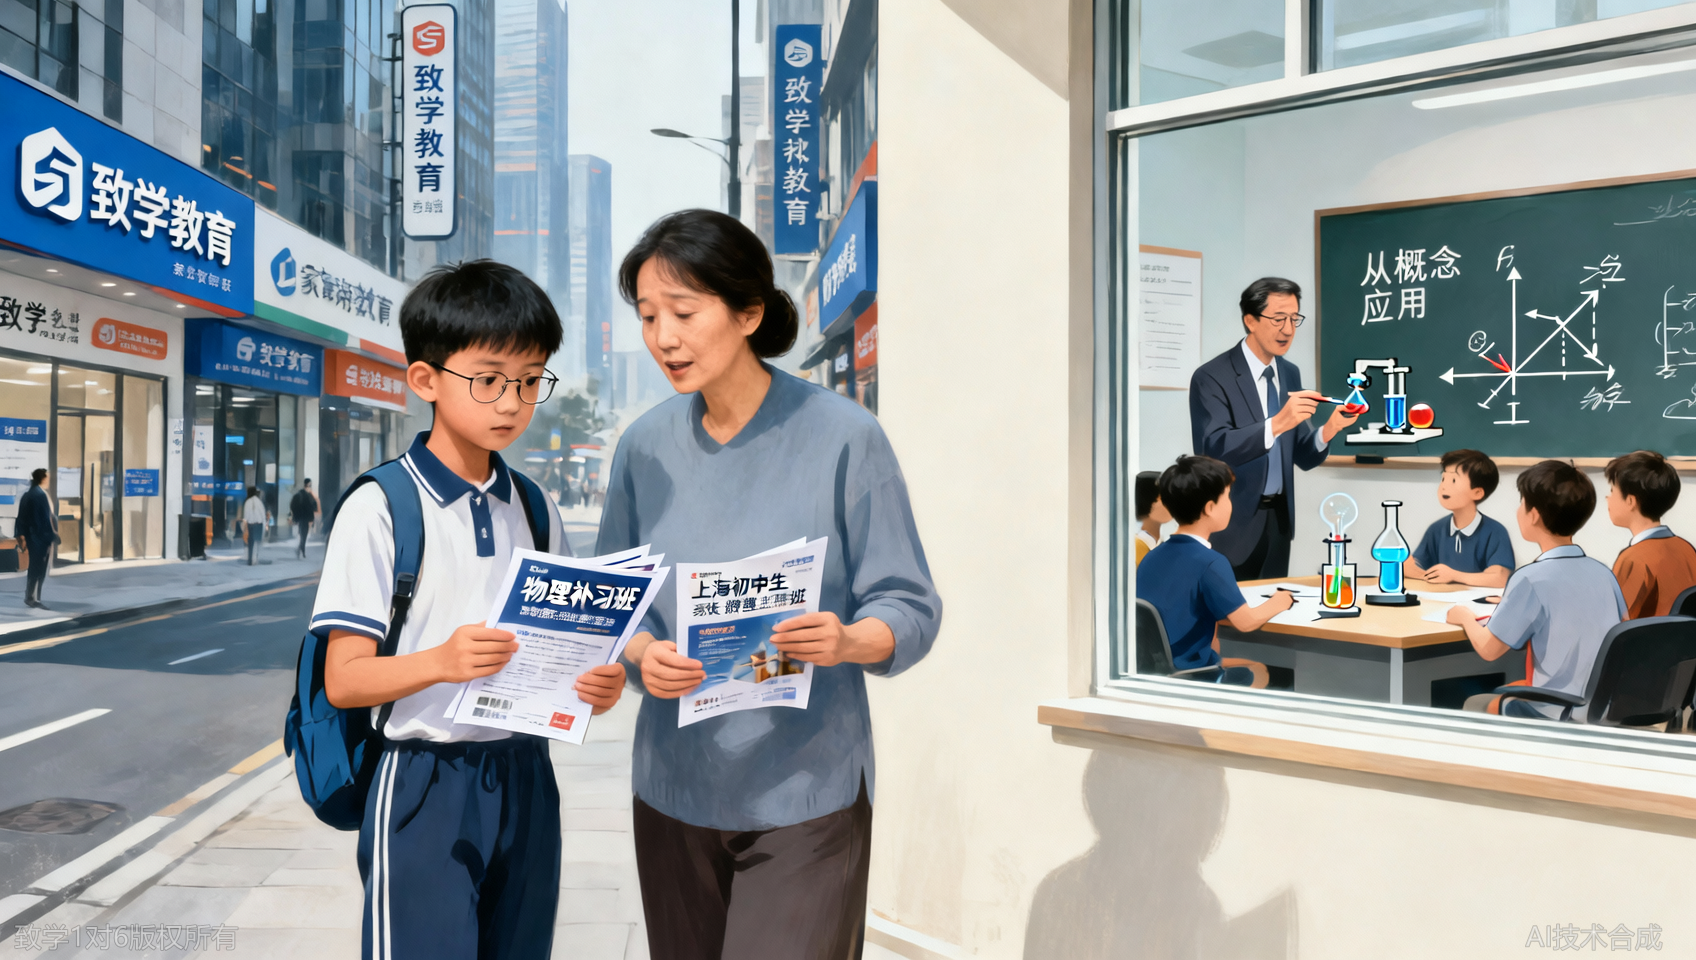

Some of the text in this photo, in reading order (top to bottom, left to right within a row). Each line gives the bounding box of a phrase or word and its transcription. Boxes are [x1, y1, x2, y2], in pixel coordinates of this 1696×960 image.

[413, 64, 445, 193] 致学教育
[90, 161, 236, 266] 致学教育
[1360, 244, 1462, 287] 从概念
[1361, 287, 1427, 326] 应用
[520, 575, 641, 611] 物理补习班
[691, 572, 789, 599] 上海初中生
